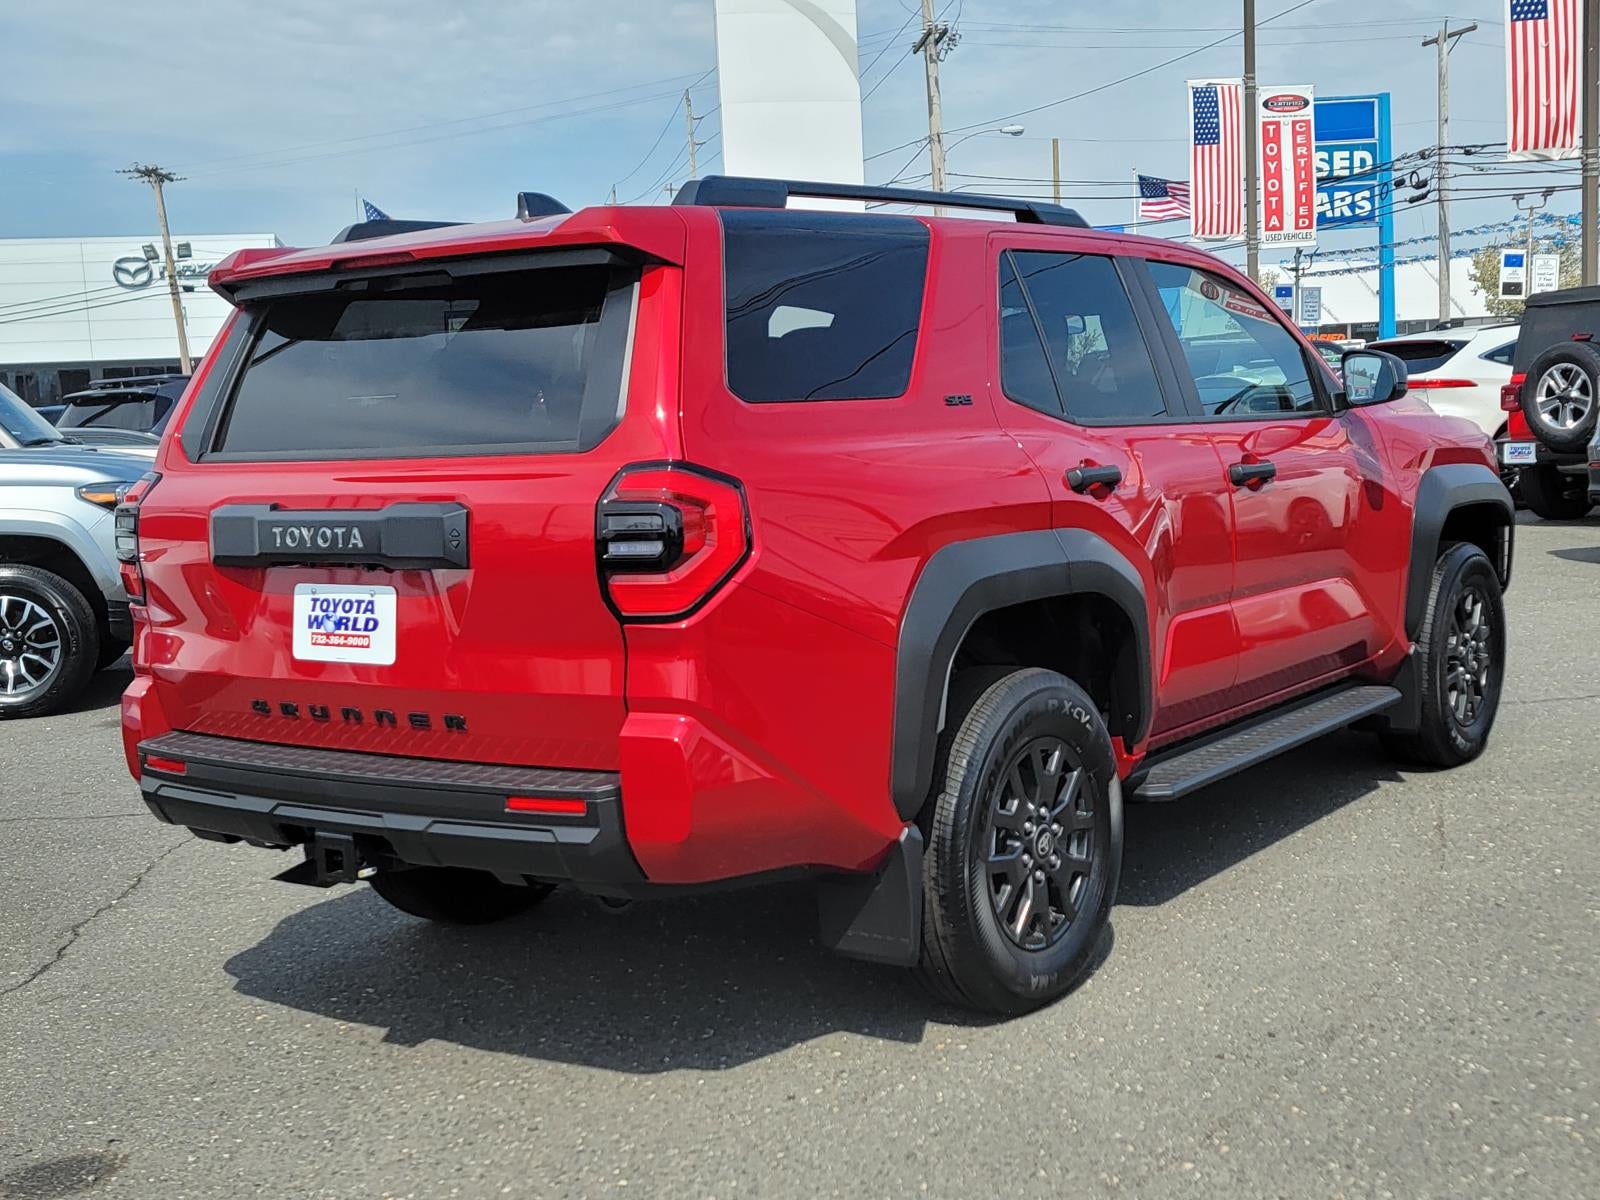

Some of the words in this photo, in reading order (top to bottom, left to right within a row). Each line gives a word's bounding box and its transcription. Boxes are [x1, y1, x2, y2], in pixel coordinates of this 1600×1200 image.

[1265, 124, 1280, 228] TOYOTA
[1295, 122, 1310, 228] CERTIFIED
[1315, 150, 1373, 177] SED
[1315, 190, 1372, 217] ARS
[1265, 233, 1282, 241] USED
[1283, 232, 1313, 241] VEHICLES
[272, 526, 364, 548] TOYOTA
[310, 597, 375, 614] TOYOTA
[251, 699, 469, 732] 4RUNNER
